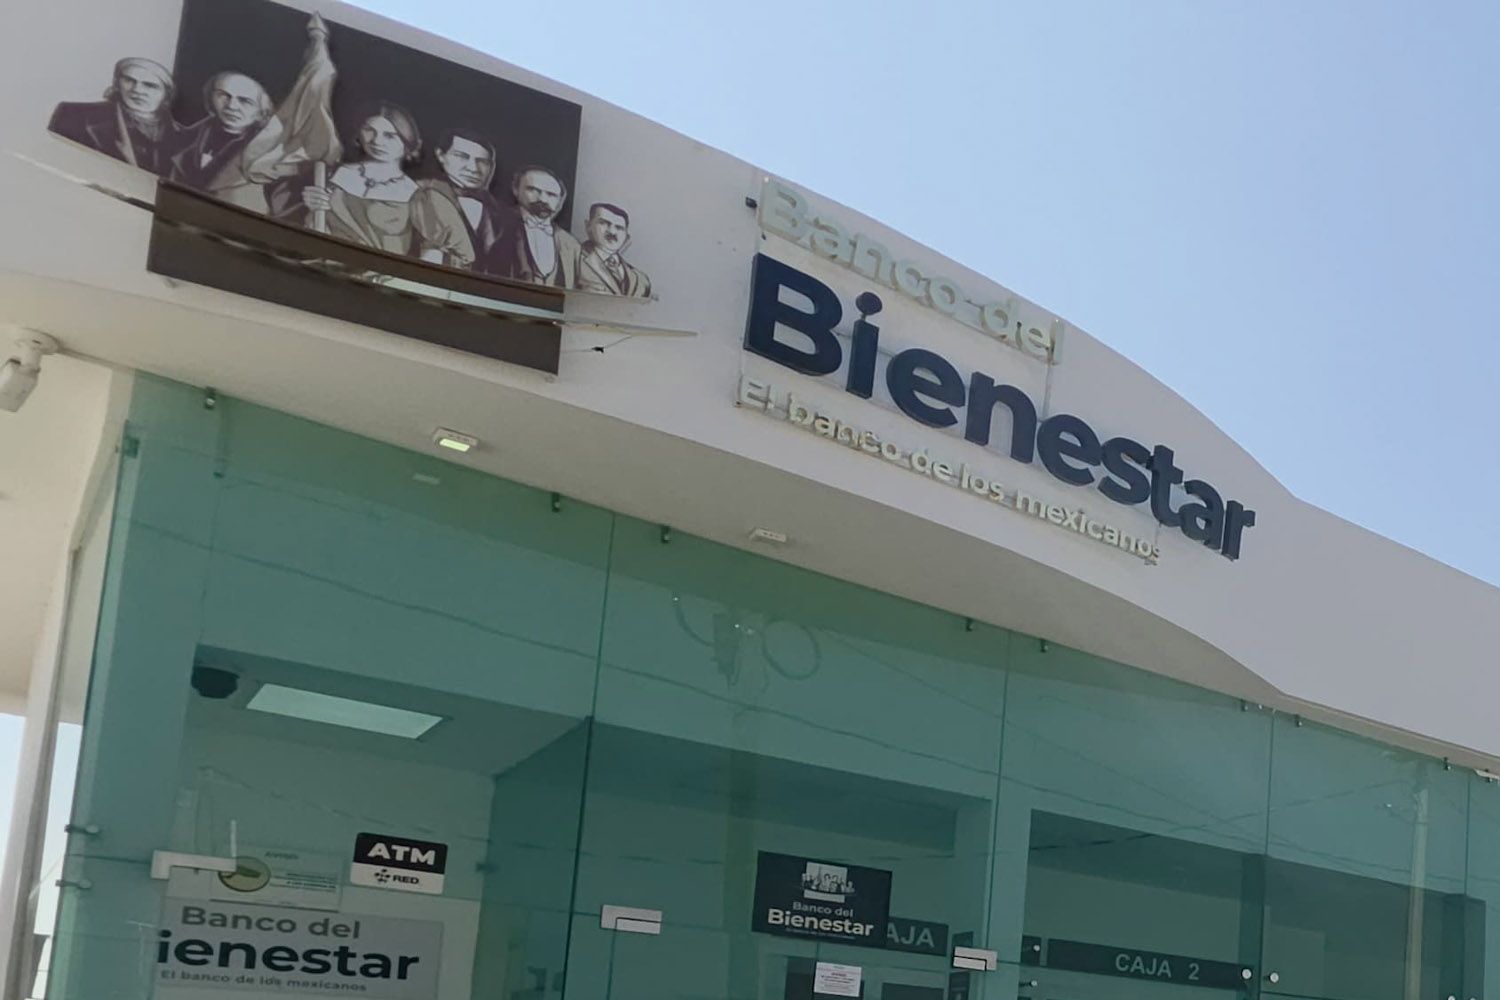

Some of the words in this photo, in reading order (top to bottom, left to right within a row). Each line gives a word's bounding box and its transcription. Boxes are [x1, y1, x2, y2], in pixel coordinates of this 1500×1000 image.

[758, 178, 966, 320] Banco
[978, 295, 1064, 366] del
[743, 251, 1256, 561] Bienestar
[739, 374, 778, 412] El
[788, 390, 906, 462] banco
[910, 446, 952, 481] de
[960, 461, 1006, 502] los
[1016, 487, 1162, 564] mexicanos
[367, 841, 437, 866] ATM
[392, 873, 420, 885] RED
[181, 906, 297, 934] Banco
[308, 918, 360, 939] del
[767, 907, 875, 937] Bienestar
[793, 901, 832, 916] Banco
[834, 906, 854, 918] del
[885, 921, 936, 948] AJA
[157, 929, 420, 981] ienestar
[1115, 953, 1172, 979] CAJA
[1188, 962, 1201, 981] 2
[180, 971, 230, 983] banco
[235, 974, 255, 985] de
[287, 979, 367, 992] mexicanos
